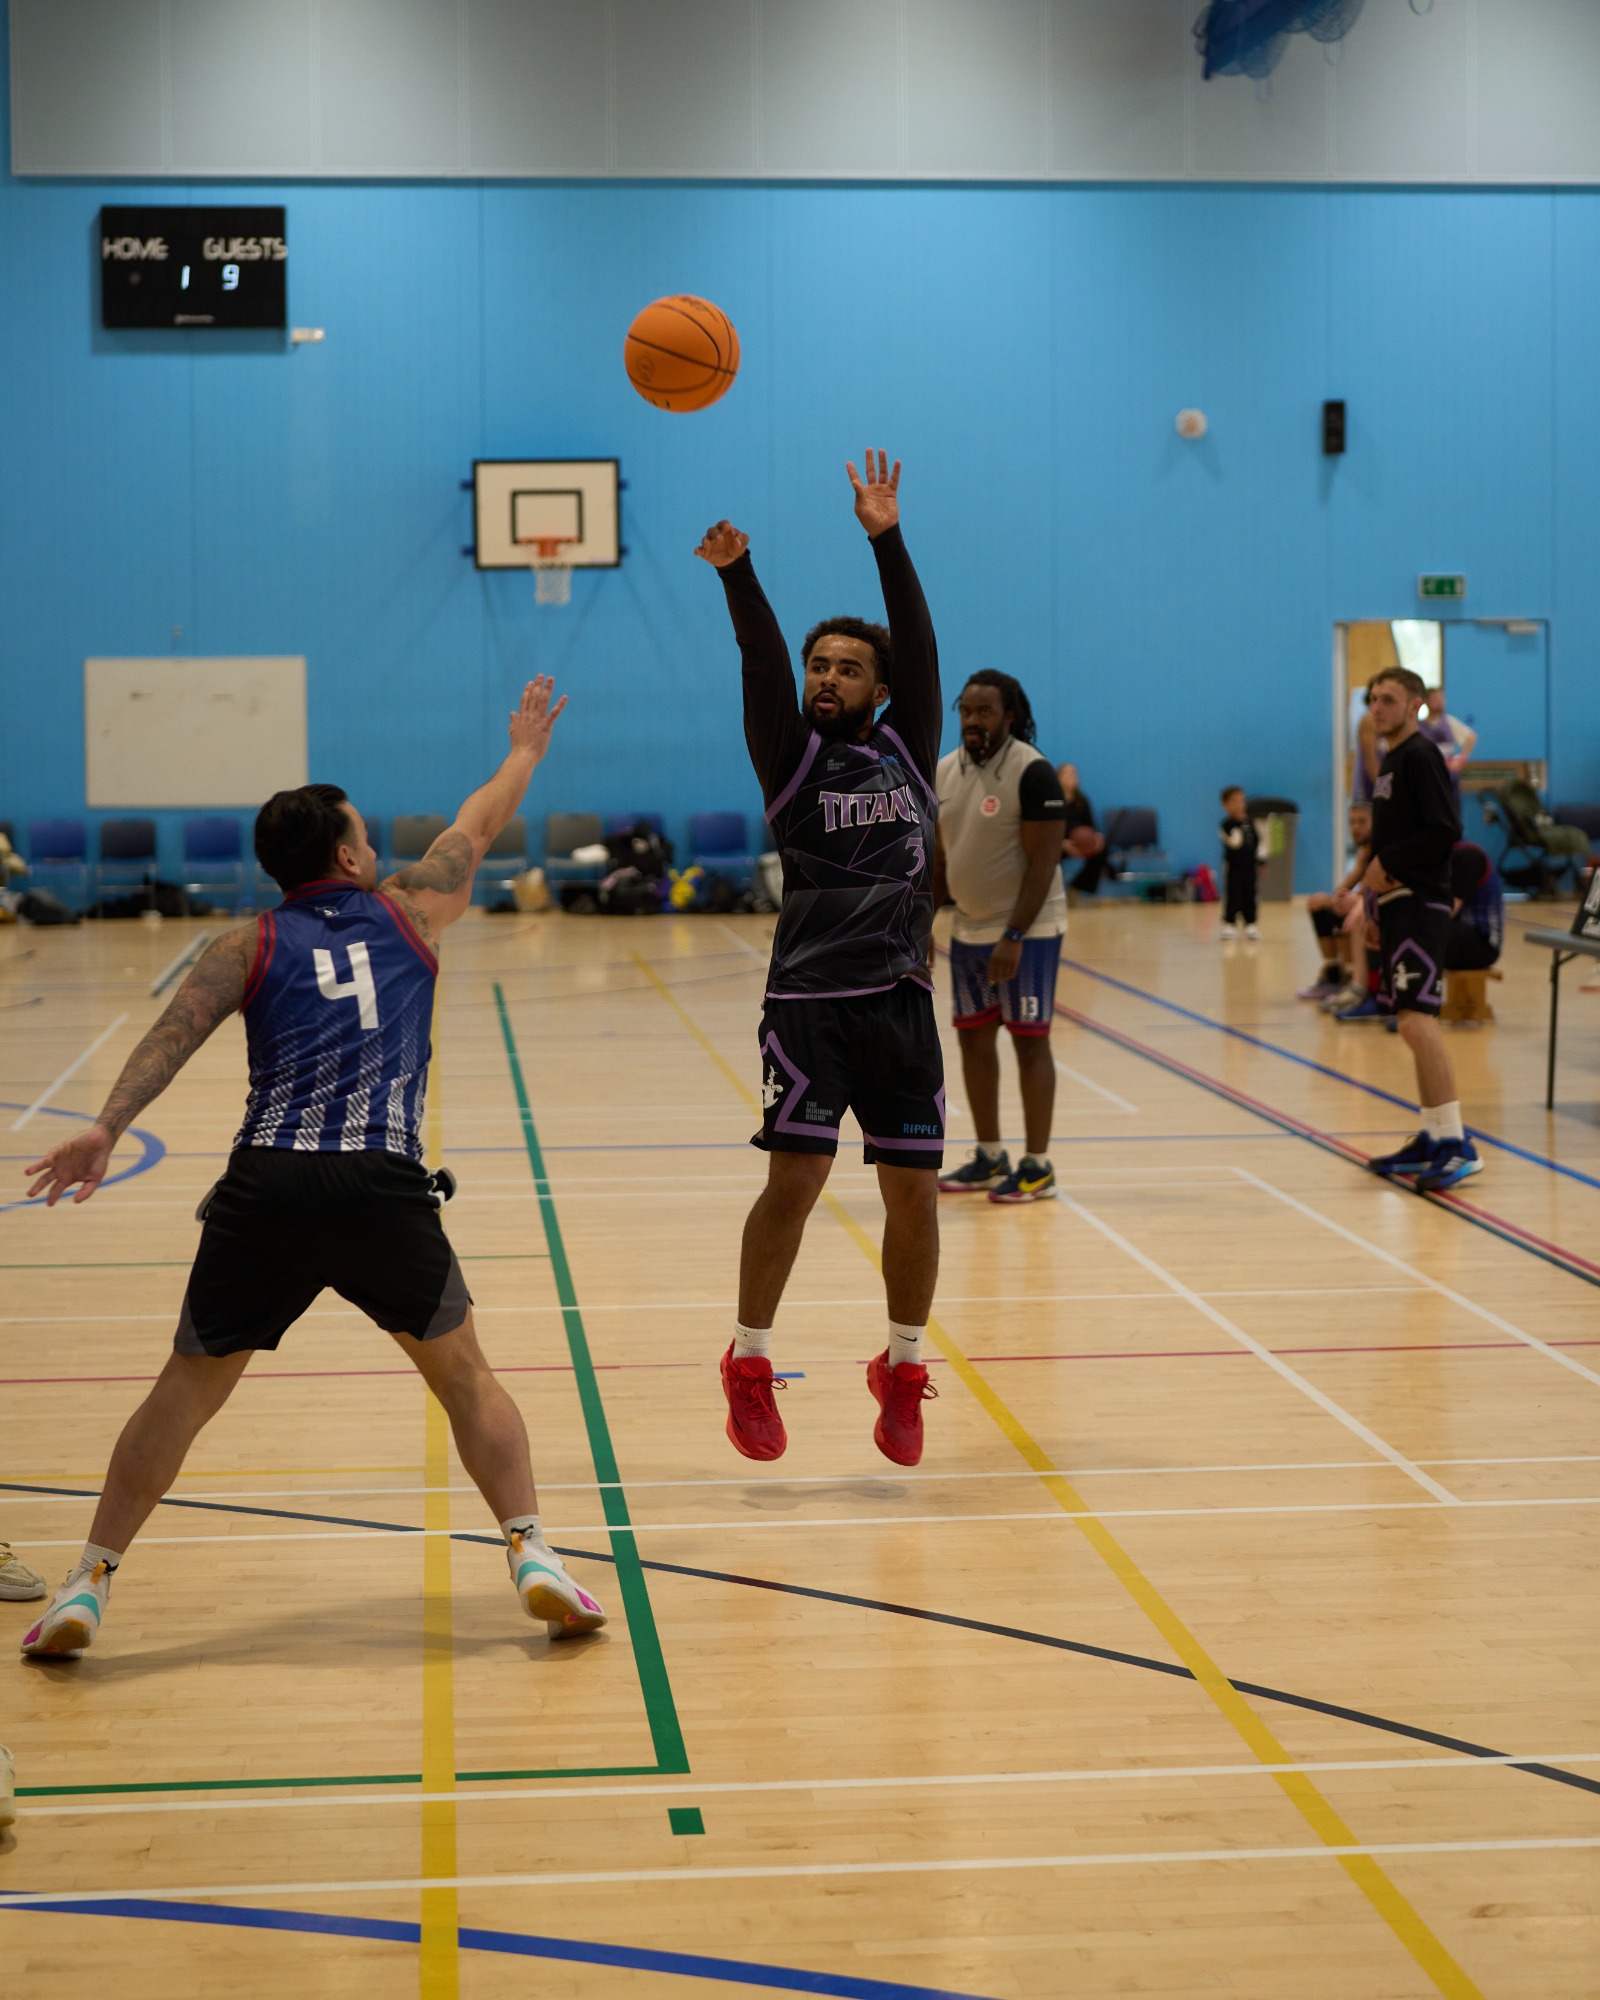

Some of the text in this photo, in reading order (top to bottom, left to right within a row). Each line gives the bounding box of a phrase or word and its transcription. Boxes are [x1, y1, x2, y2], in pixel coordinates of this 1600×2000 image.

[102, 237, 169, 260] HOME
[203, 237, 287, 260] GUESTS
[180, 264, 190, 290] 1
[222, 264, 240, 291] 9
[905, 837, 925, 877] 3
[313, 941, 380, 1030] 4
[1020, 995, 1039, 1016] 13
[805, 1100, 817, 1108] THE
[805, 1107, 834, 1117] MINIMUM
[805, 1113, 826, 1122] BRAND
[903, 1123, 938, 1135] RIPPLE
